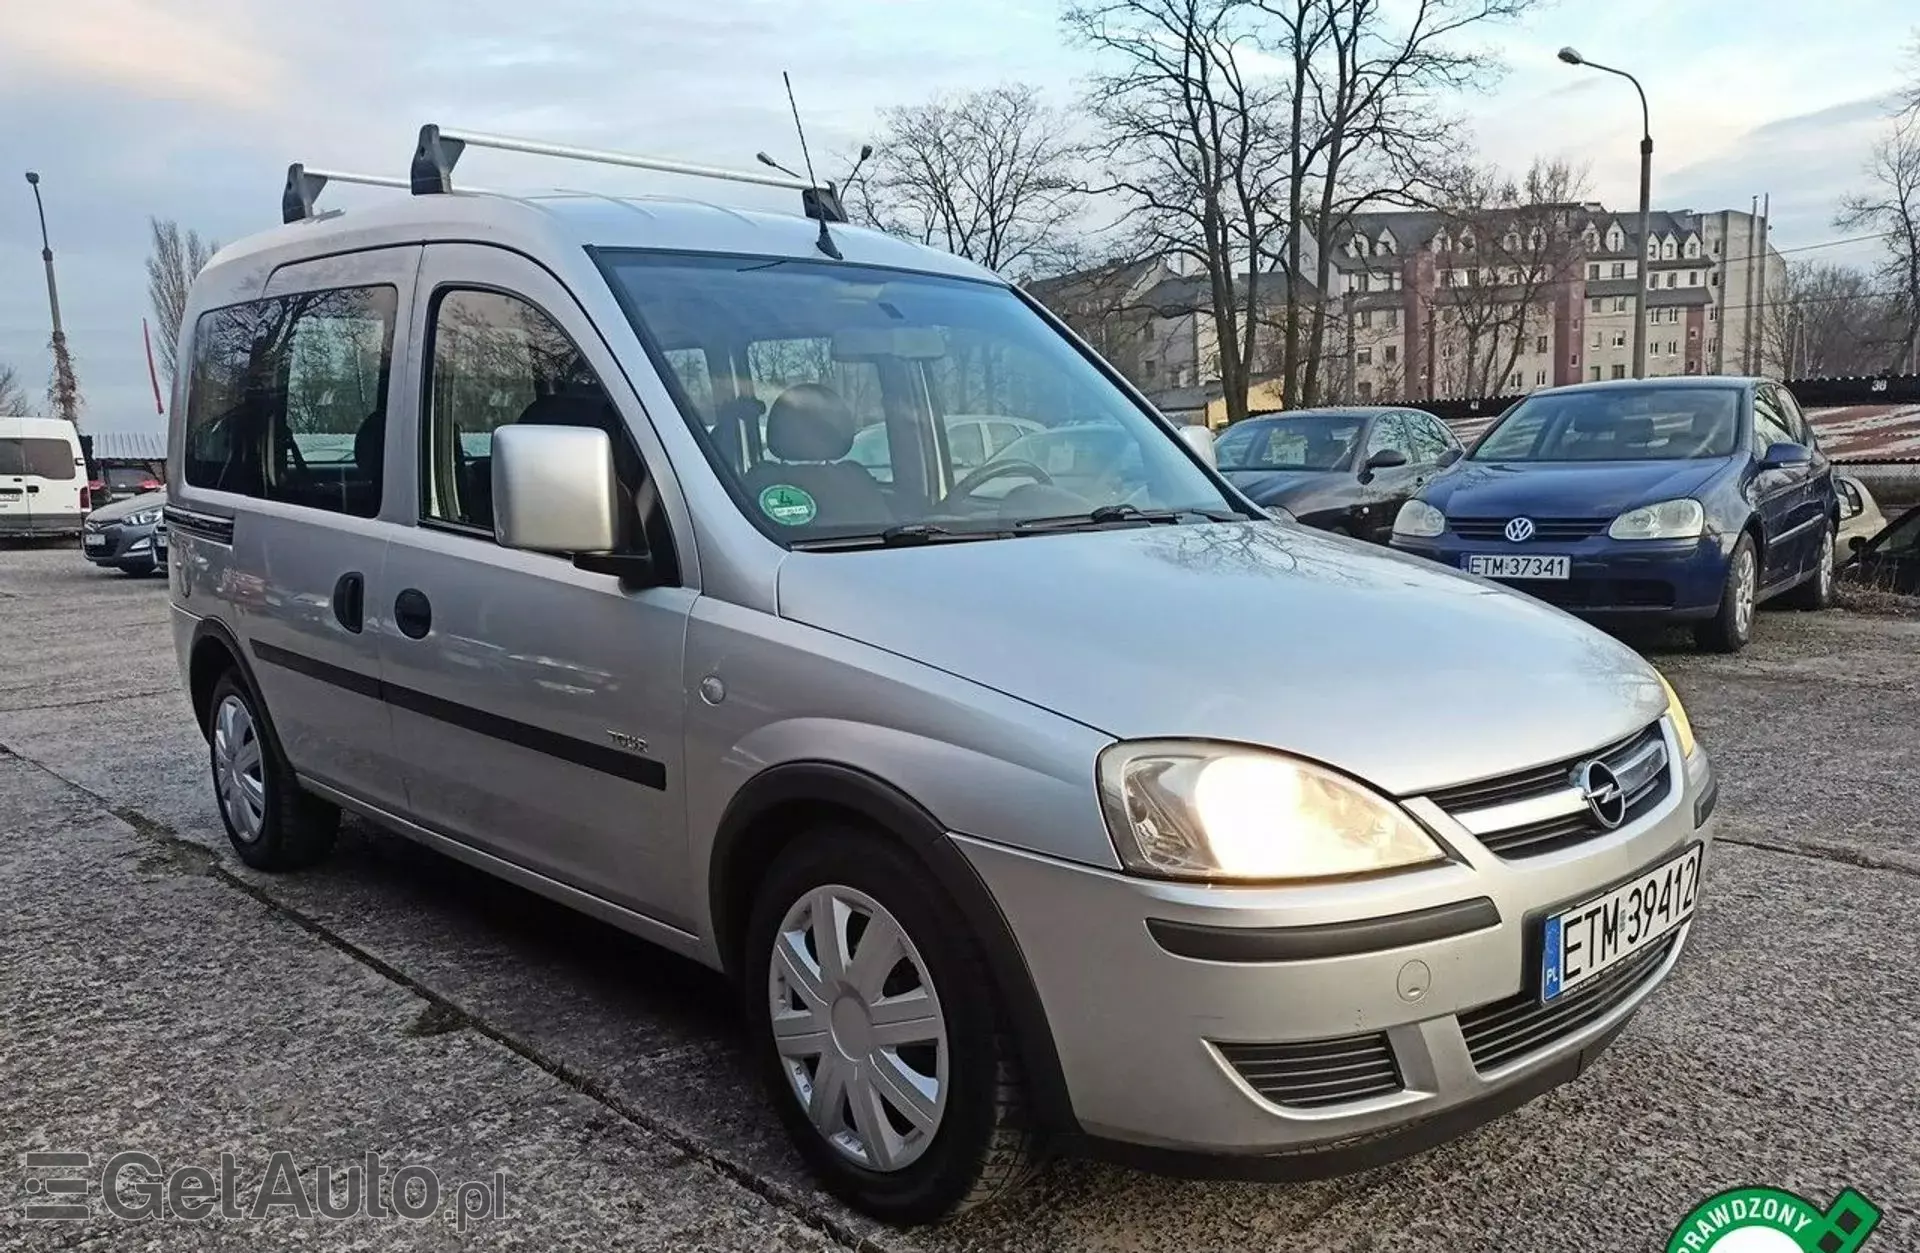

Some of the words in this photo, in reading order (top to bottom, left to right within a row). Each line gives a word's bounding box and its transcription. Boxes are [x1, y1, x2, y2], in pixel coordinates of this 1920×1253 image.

[1470, 557, 1504, 575] ETM
[1509, 558, 1565, 577] 37341
[1563, 896, 1620, 982] ETM
[1627, 856, 1696, 944] 39412
[1545, 968, 1559, 986] PL
